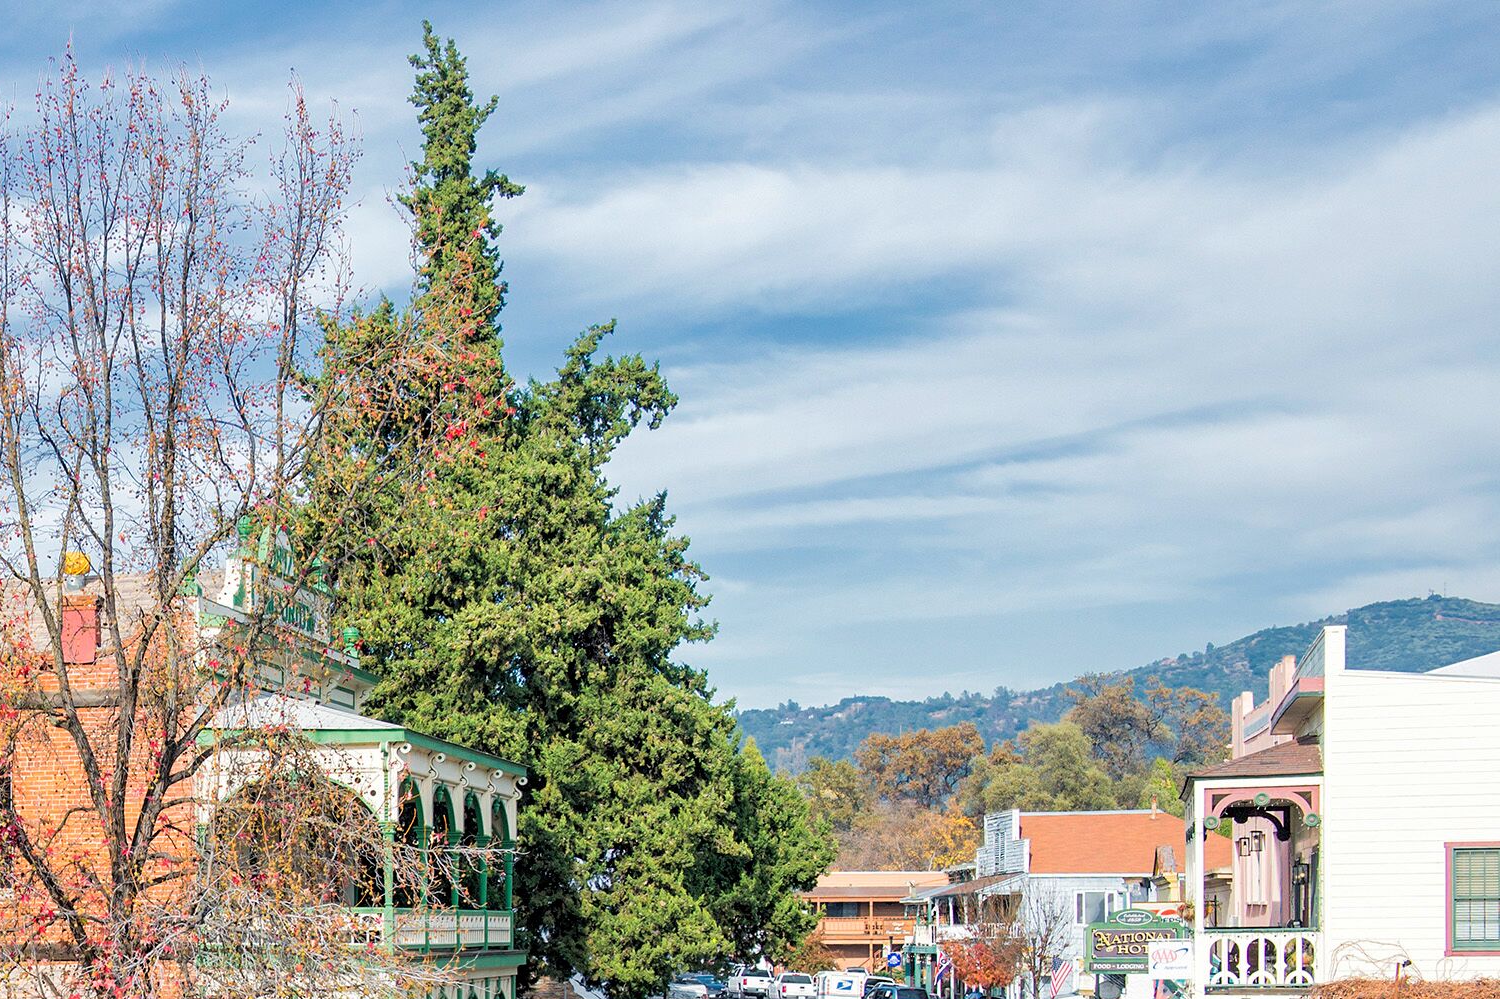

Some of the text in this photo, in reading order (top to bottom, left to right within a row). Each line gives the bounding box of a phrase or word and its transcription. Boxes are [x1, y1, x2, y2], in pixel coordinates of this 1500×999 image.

[1095, 931, 1172, 949] NATIONAL
[1117, 944, 1148, 954] HOT
[1152, 948, 1177, 962] AAA
